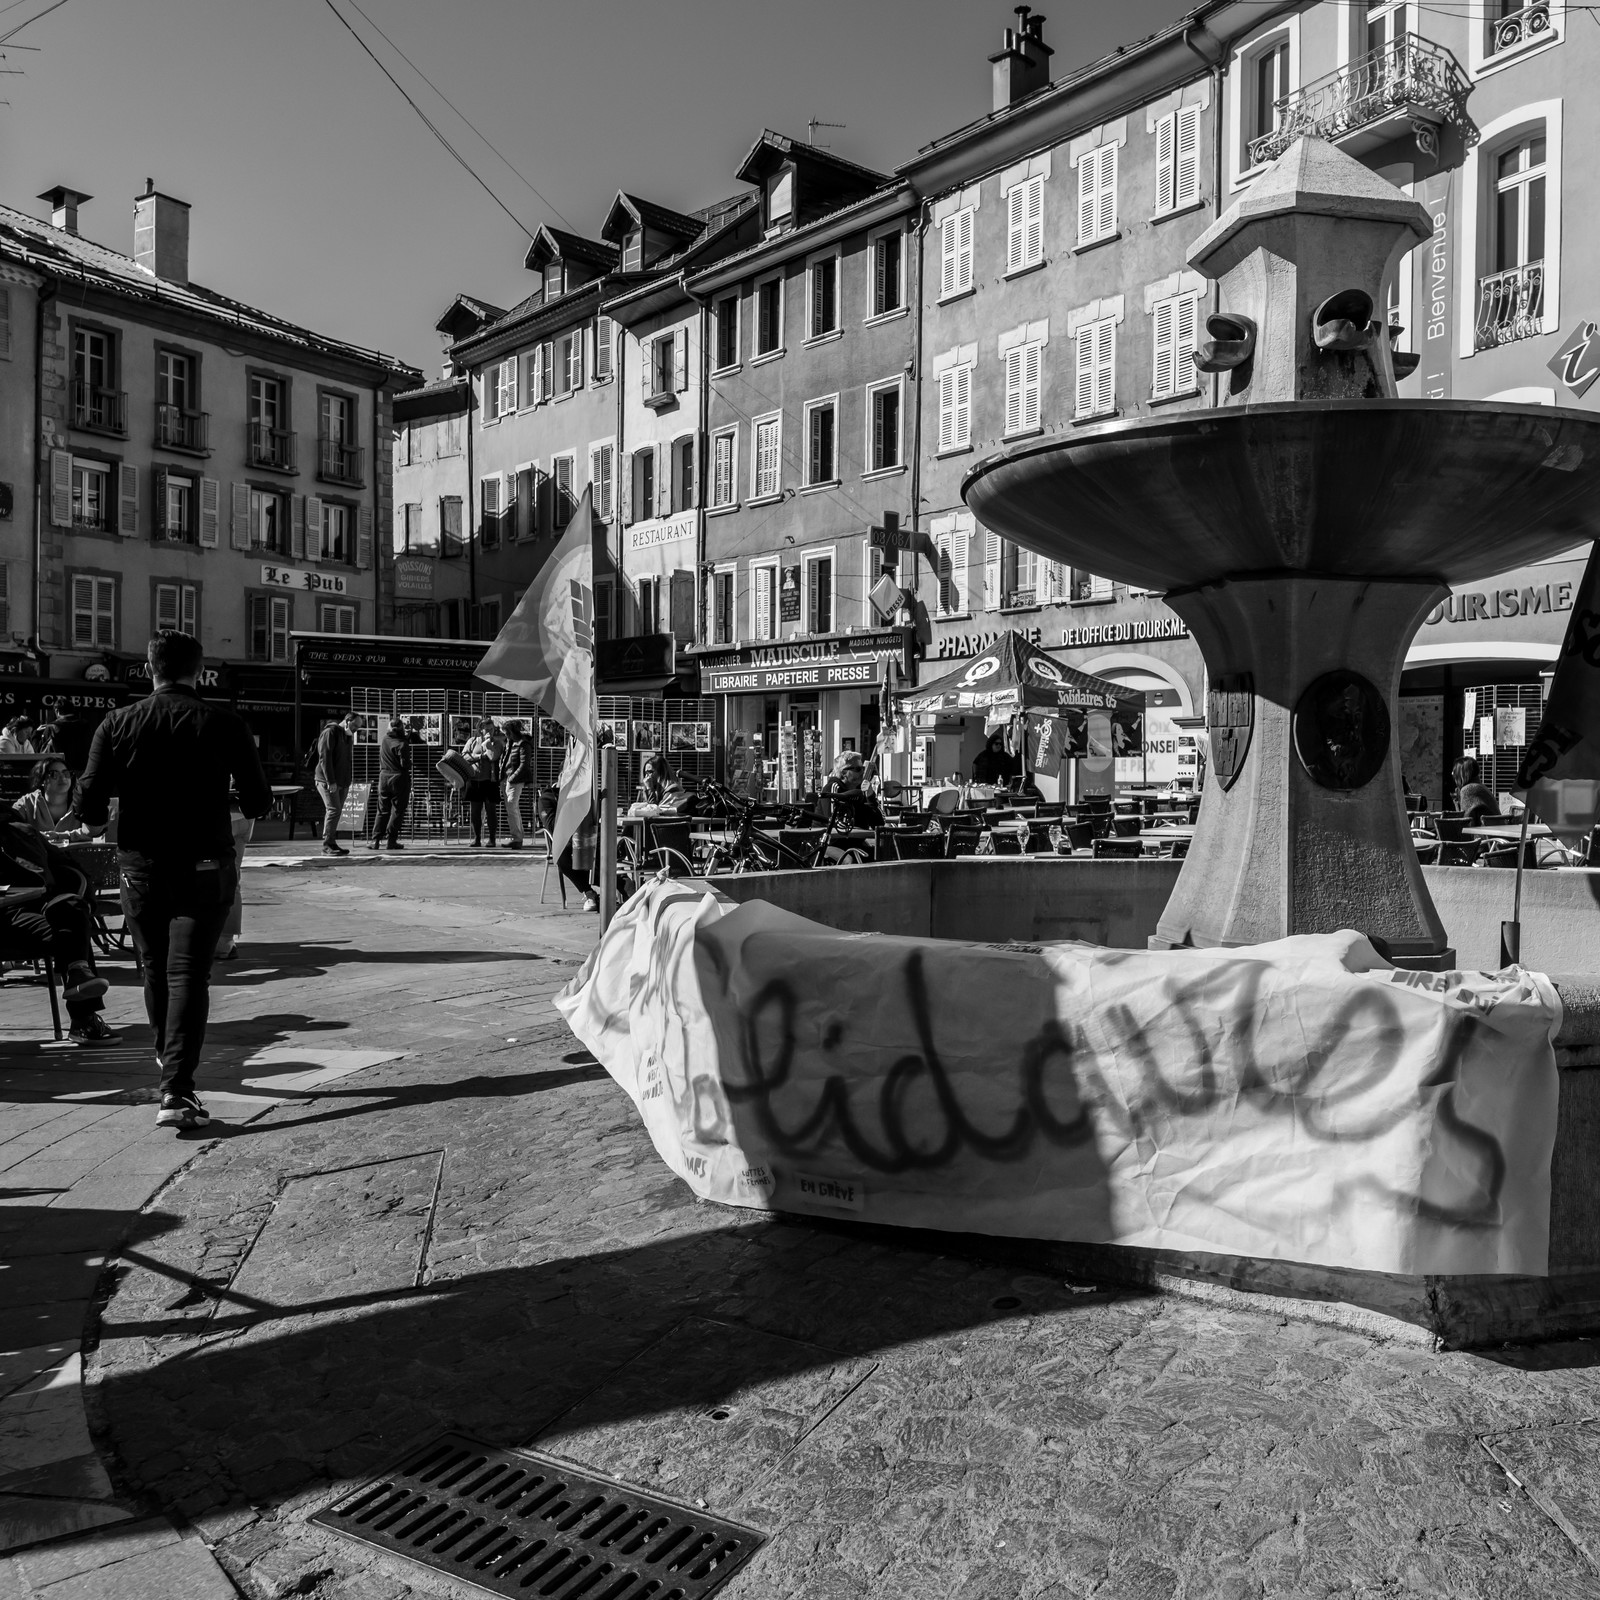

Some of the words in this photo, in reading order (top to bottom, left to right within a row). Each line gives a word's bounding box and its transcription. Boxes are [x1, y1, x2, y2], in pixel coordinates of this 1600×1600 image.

[1427, 211, 1447, 340] Bienvenue
[632, 520, 694, 548] RESTAURANT
[264, 567, 291, 584] Le
[304, 572, 344, 592] Pub
[397, 582, 433, 590] VOLAILLES
[885, 594, 904, 617] PRESSE
[1424, 582, 1574, 625] OURISME
[849, 637, 875, 647] MADISON
[876, 635, 902, 645] NUGGETS
[938, 627, 1040, 658] PHARMIE
[1061, 628, 1074, 646] DE
[1075, 624, 1114, 645] L'OFFICE
[1115, 621, 1131, 642] DU
[1133, 617, 1186, 640] TOURISME
[308, 651, 329, 661] THE
[332, 653, 362, 663] DED'S
[365, 654, 387, 664] PUB
[402, 657, 423, 666] BAR
[427, 658, 480, 669] RESTAURAN
[750, 641, 840, 668] MAJUSCULE
[714, 675, 758, 690] LIBRAIRIE
[765, 670, 819, 686] PAPETERIE
[827, 666, 870, 682] PRESSE
[1057, 689, 1104, 707] Solidaires
[1142, 740, 1176, 753] ONSEI
[1130, 759, 1155, 773] PRX
[801, 1179, 815, 1193] EN
[818, 1181, 854, 1202] GRÈVE
